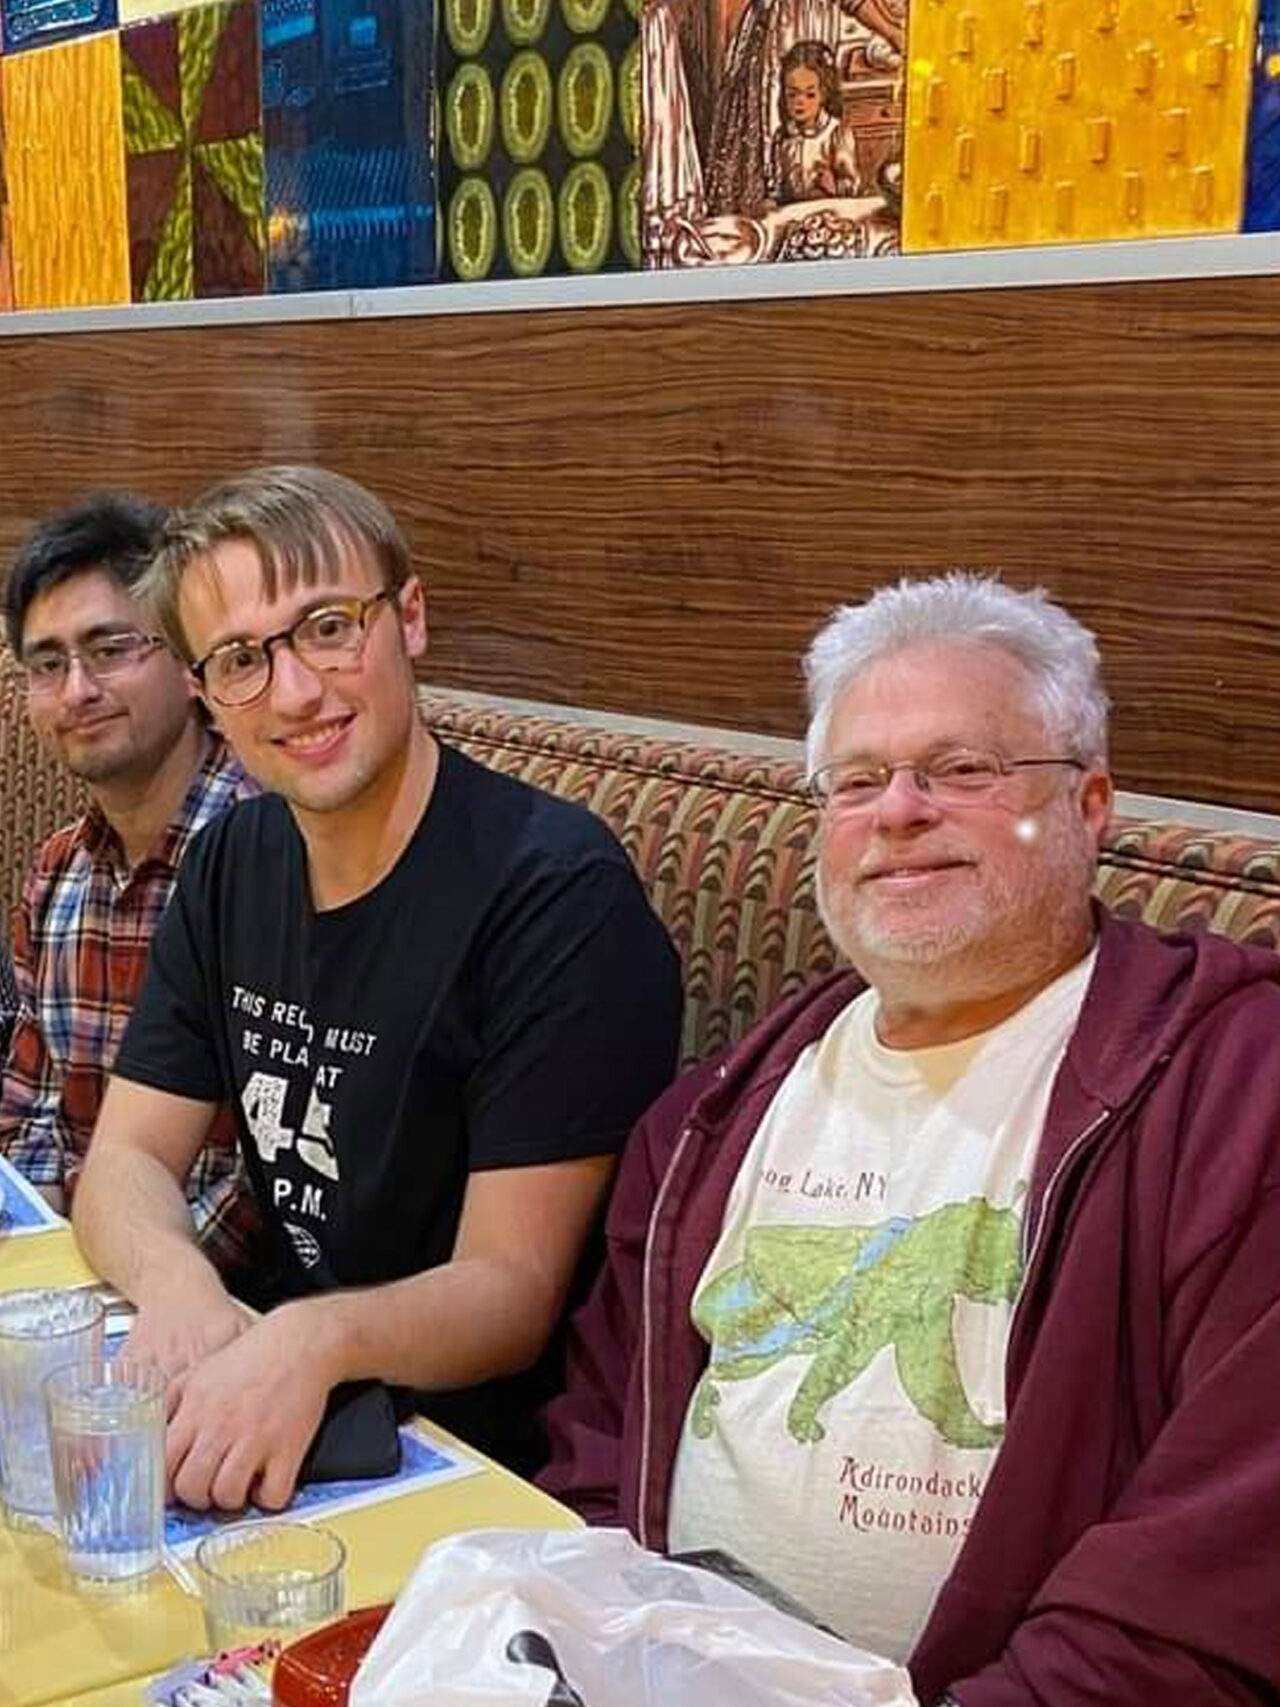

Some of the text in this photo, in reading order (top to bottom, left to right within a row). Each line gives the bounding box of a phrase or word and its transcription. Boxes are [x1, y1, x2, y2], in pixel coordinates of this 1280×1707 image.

[232, 985, 377, 1056] THIS REC MUST
[242, 1029, 344, 1089] BE PLA AT
[854, 1171, 891, 1202] NY
[839, 1456, 982, 1498] Adirondack
